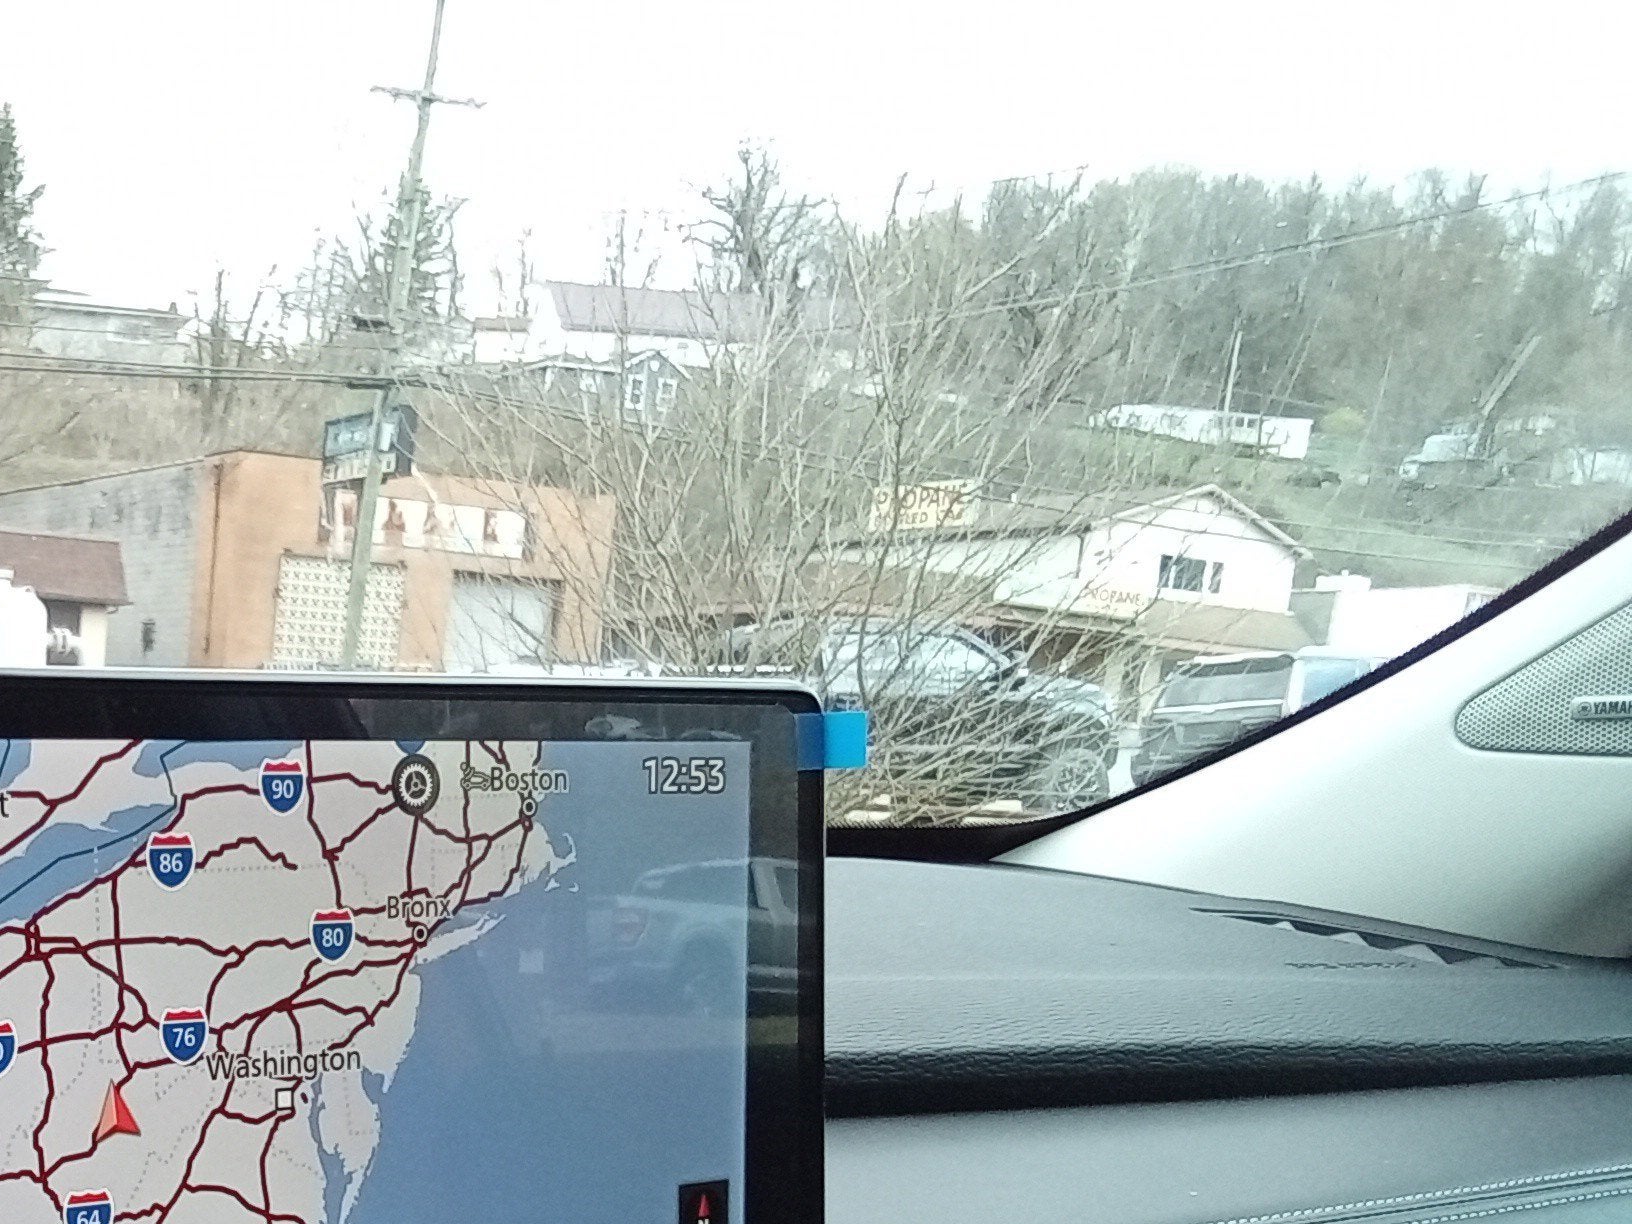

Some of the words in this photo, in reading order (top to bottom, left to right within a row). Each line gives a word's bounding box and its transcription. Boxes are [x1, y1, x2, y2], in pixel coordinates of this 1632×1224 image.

[491, 768, 567, 791] Boston
[643, 757, 726, 794] 12:53
[272, 780, 294, 799] 90
[159, 854, 183, 873] 86
[387, 897, 450, 919] Bronx
[322, 929, 344, 947] 80
[173, 1028, 196, 1047] 76
[206, 1046, 361, 1081] Washington
